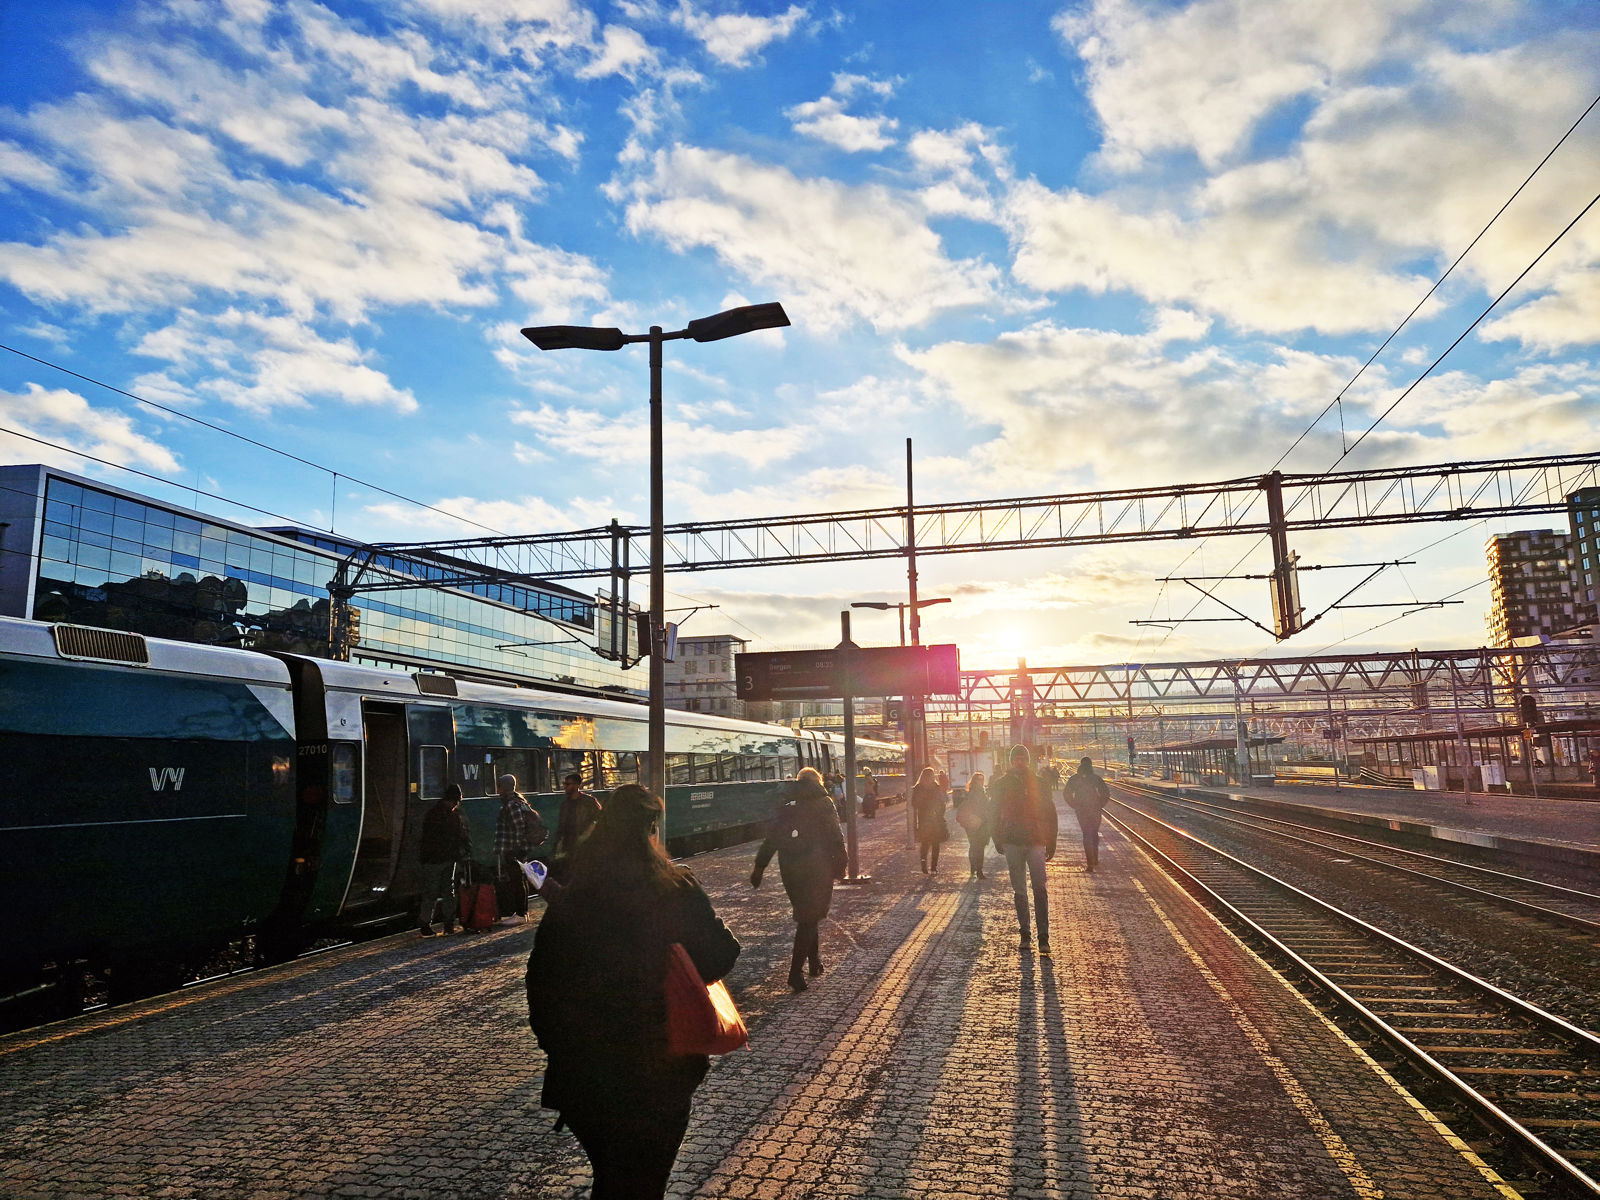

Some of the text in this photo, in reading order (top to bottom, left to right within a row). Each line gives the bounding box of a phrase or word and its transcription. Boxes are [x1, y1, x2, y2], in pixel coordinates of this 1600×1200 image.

[744, 675, 753, 691] 3
[889, 709, 898, 719] G
[912, 708, 921, 718] G
[298, 743, 328, 756] 27010
